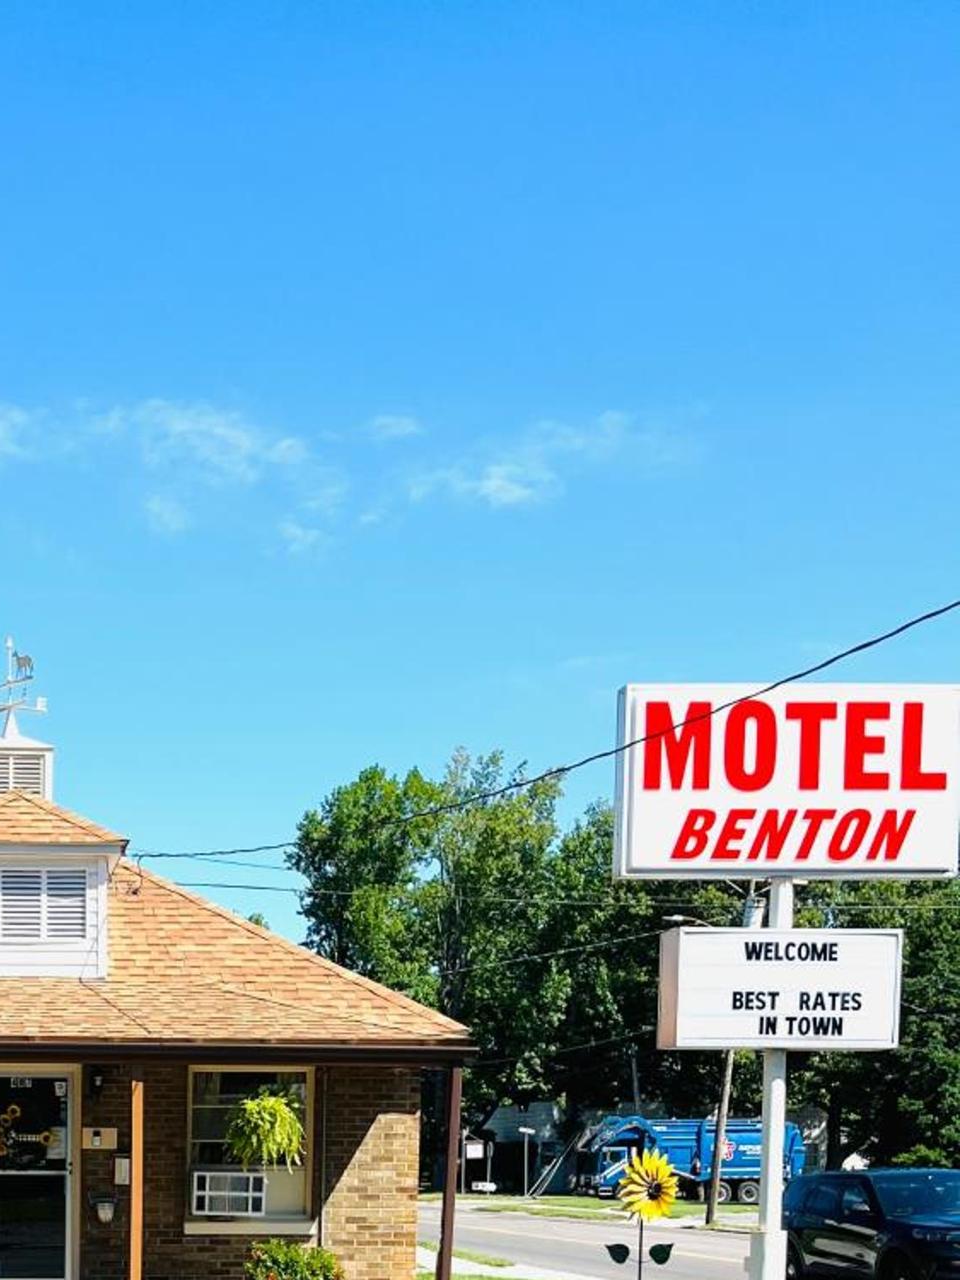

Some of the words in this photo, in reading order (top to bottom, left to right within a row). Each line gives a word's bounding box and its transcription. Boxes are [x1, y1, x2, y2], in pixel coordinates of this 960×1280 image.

[642, 699, 948, 792] MOTEL
[671, 808, 916, 863] BENTON
[744, 941, 838, 961] WELCOME
[731, 990, 780, 1010] BEST
[799, 991, 862, 1011] RATES
[758, 1016, 777, 1035] IN
[785, 1017, 843, 1036] TOWN
